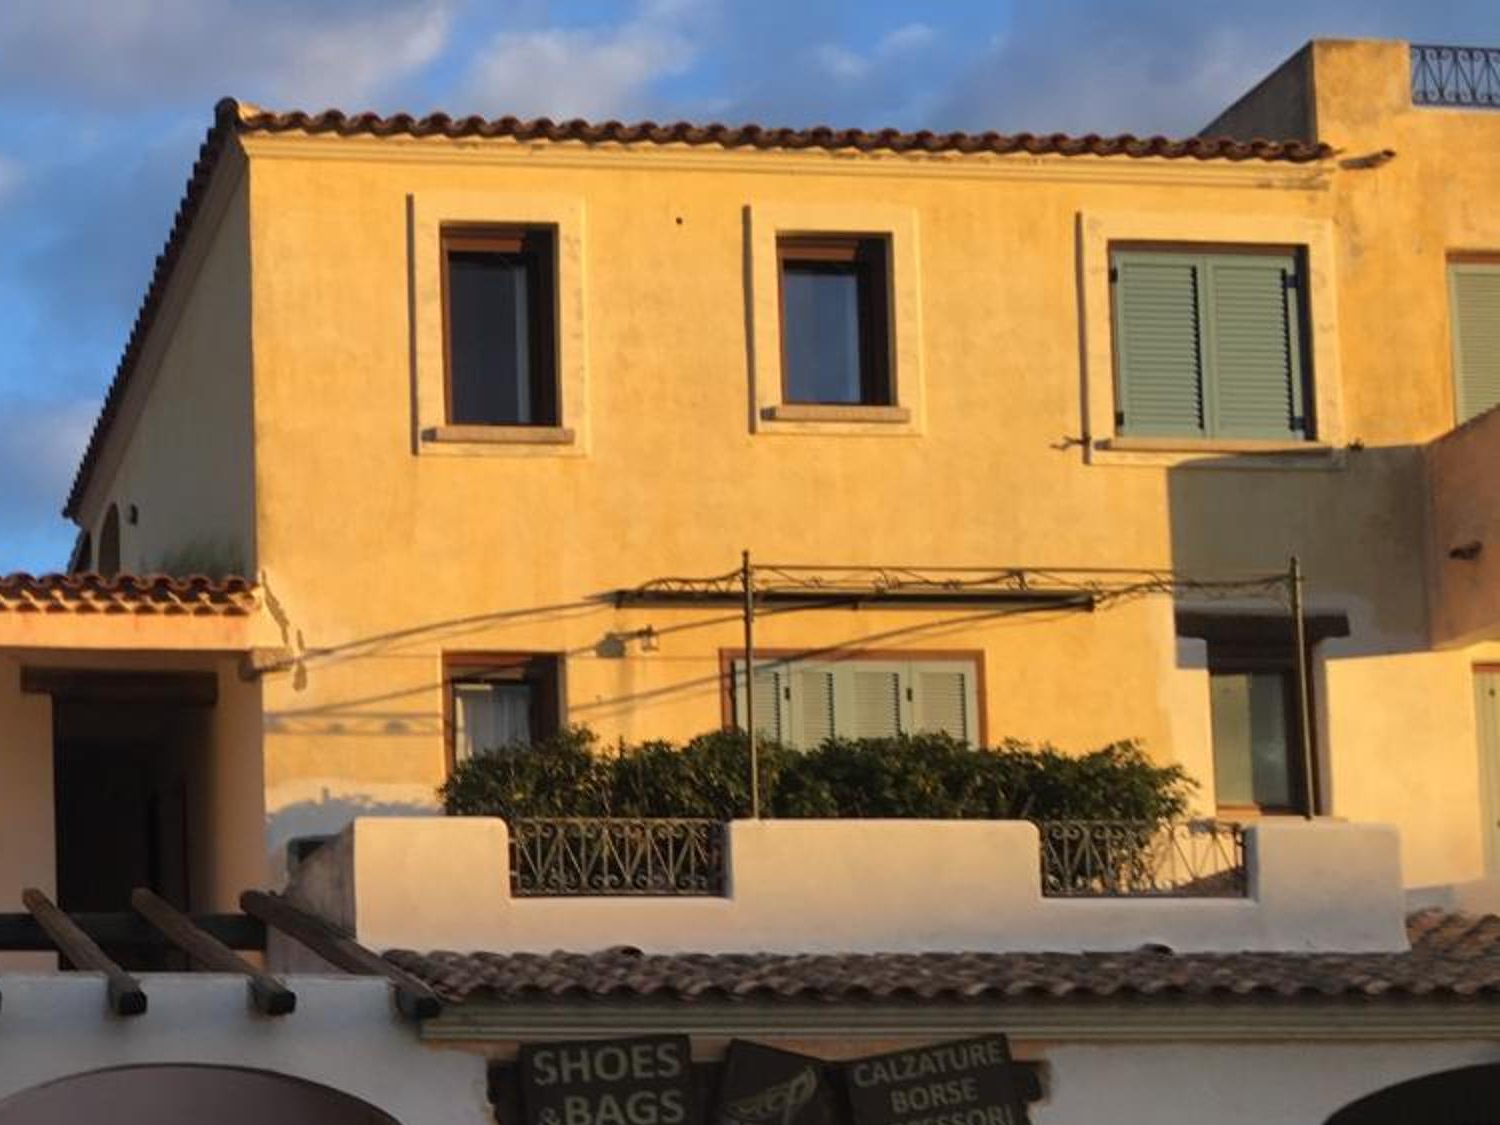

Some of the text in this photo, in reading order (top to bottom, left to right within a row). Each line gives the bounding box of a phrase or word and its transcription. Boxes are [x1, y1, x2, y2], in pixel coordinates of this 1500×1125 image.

[533, 1042, 681, 1086] SHOES
[854, 1039, 1001, 1088] CALZATURE
[890, 1077, 979, 1114] BORSE
